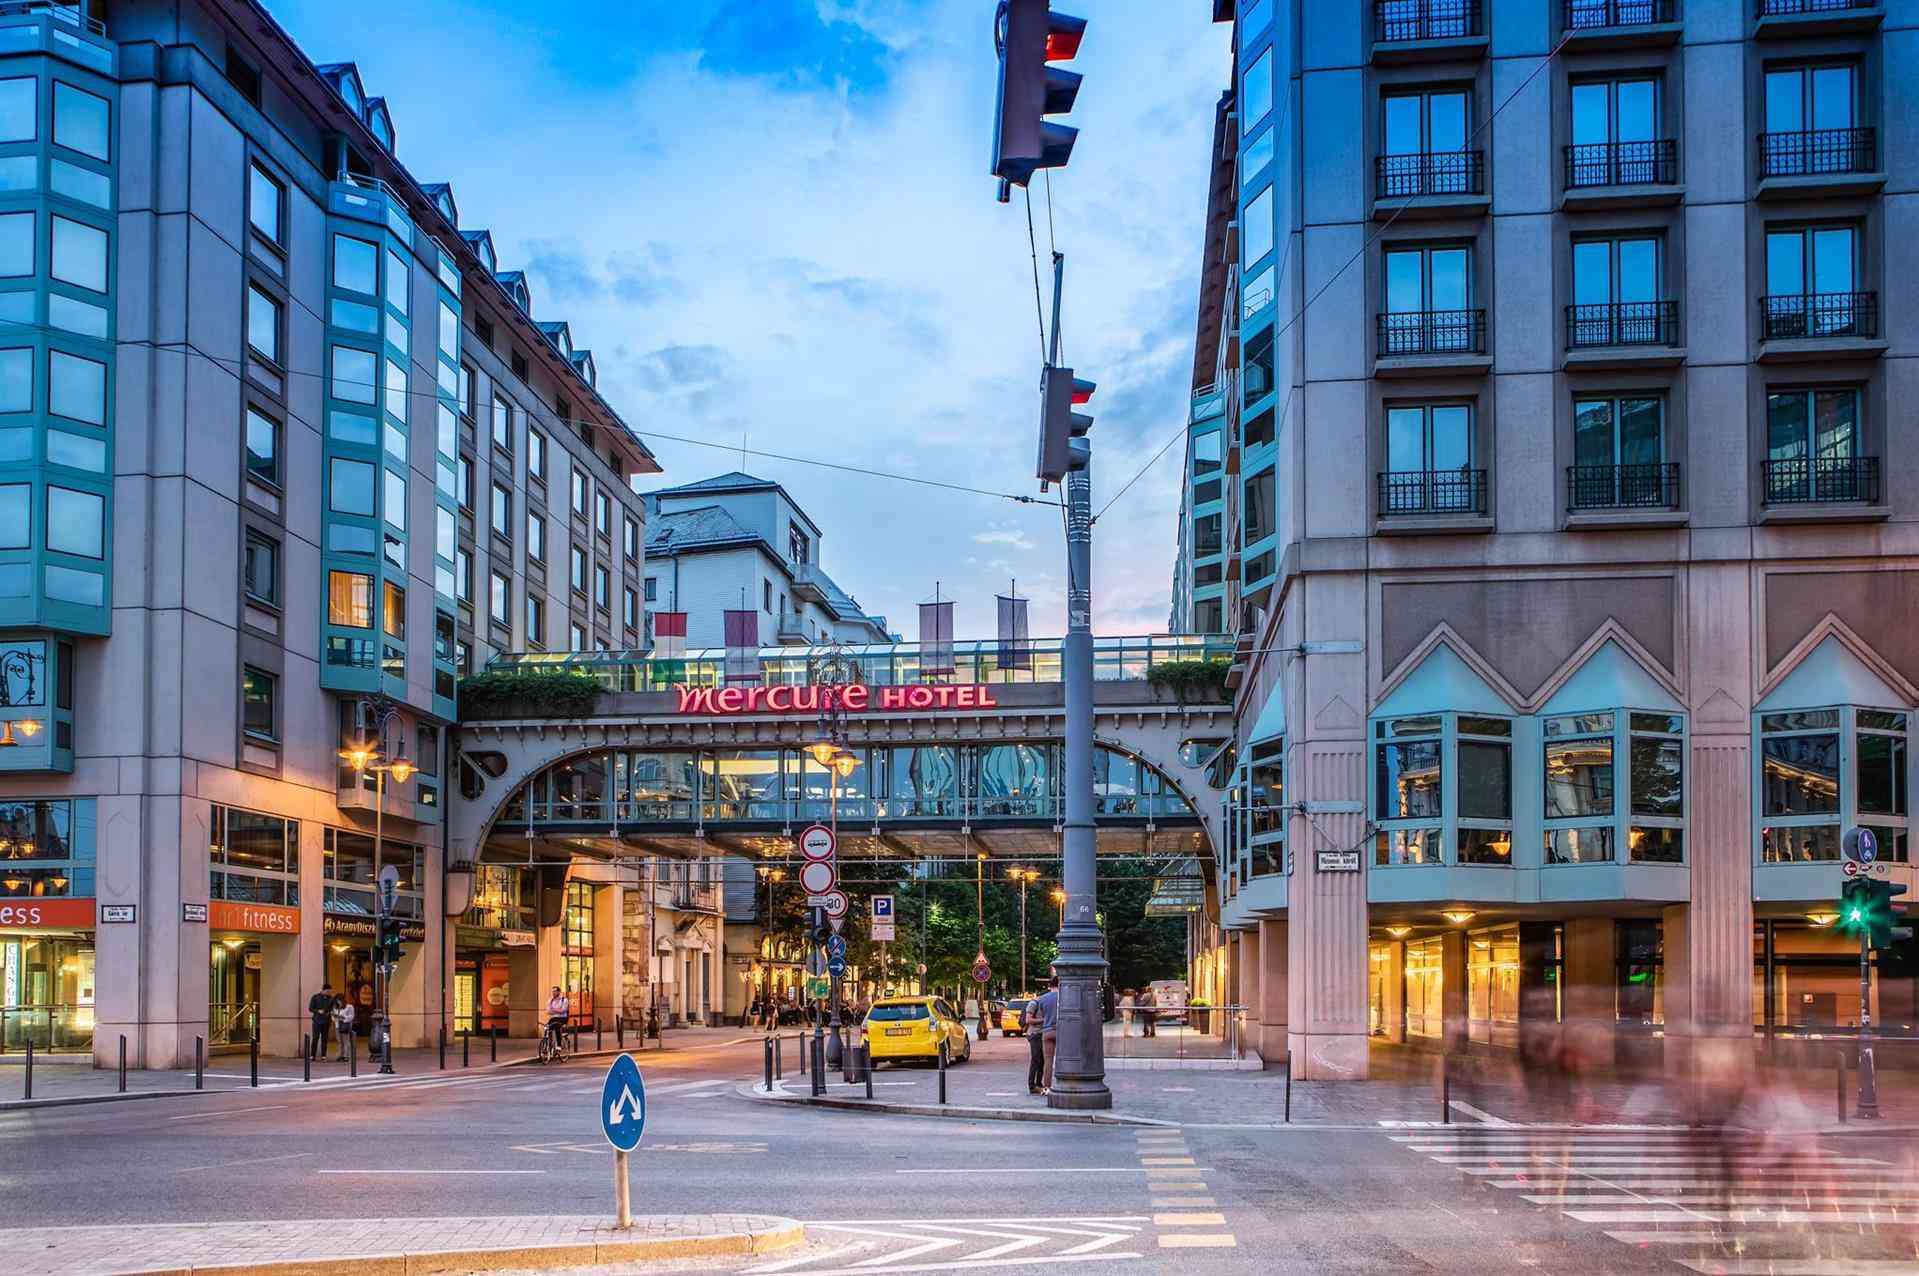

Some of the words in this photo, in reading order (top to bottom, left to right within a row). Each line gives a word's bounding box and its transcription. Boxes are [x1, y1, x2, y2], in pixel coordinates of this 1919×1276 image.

[884, 685, 997, 708] HOTEL
[877, 899, 888, 914] P
[243, 907, 293, 930] fitness
